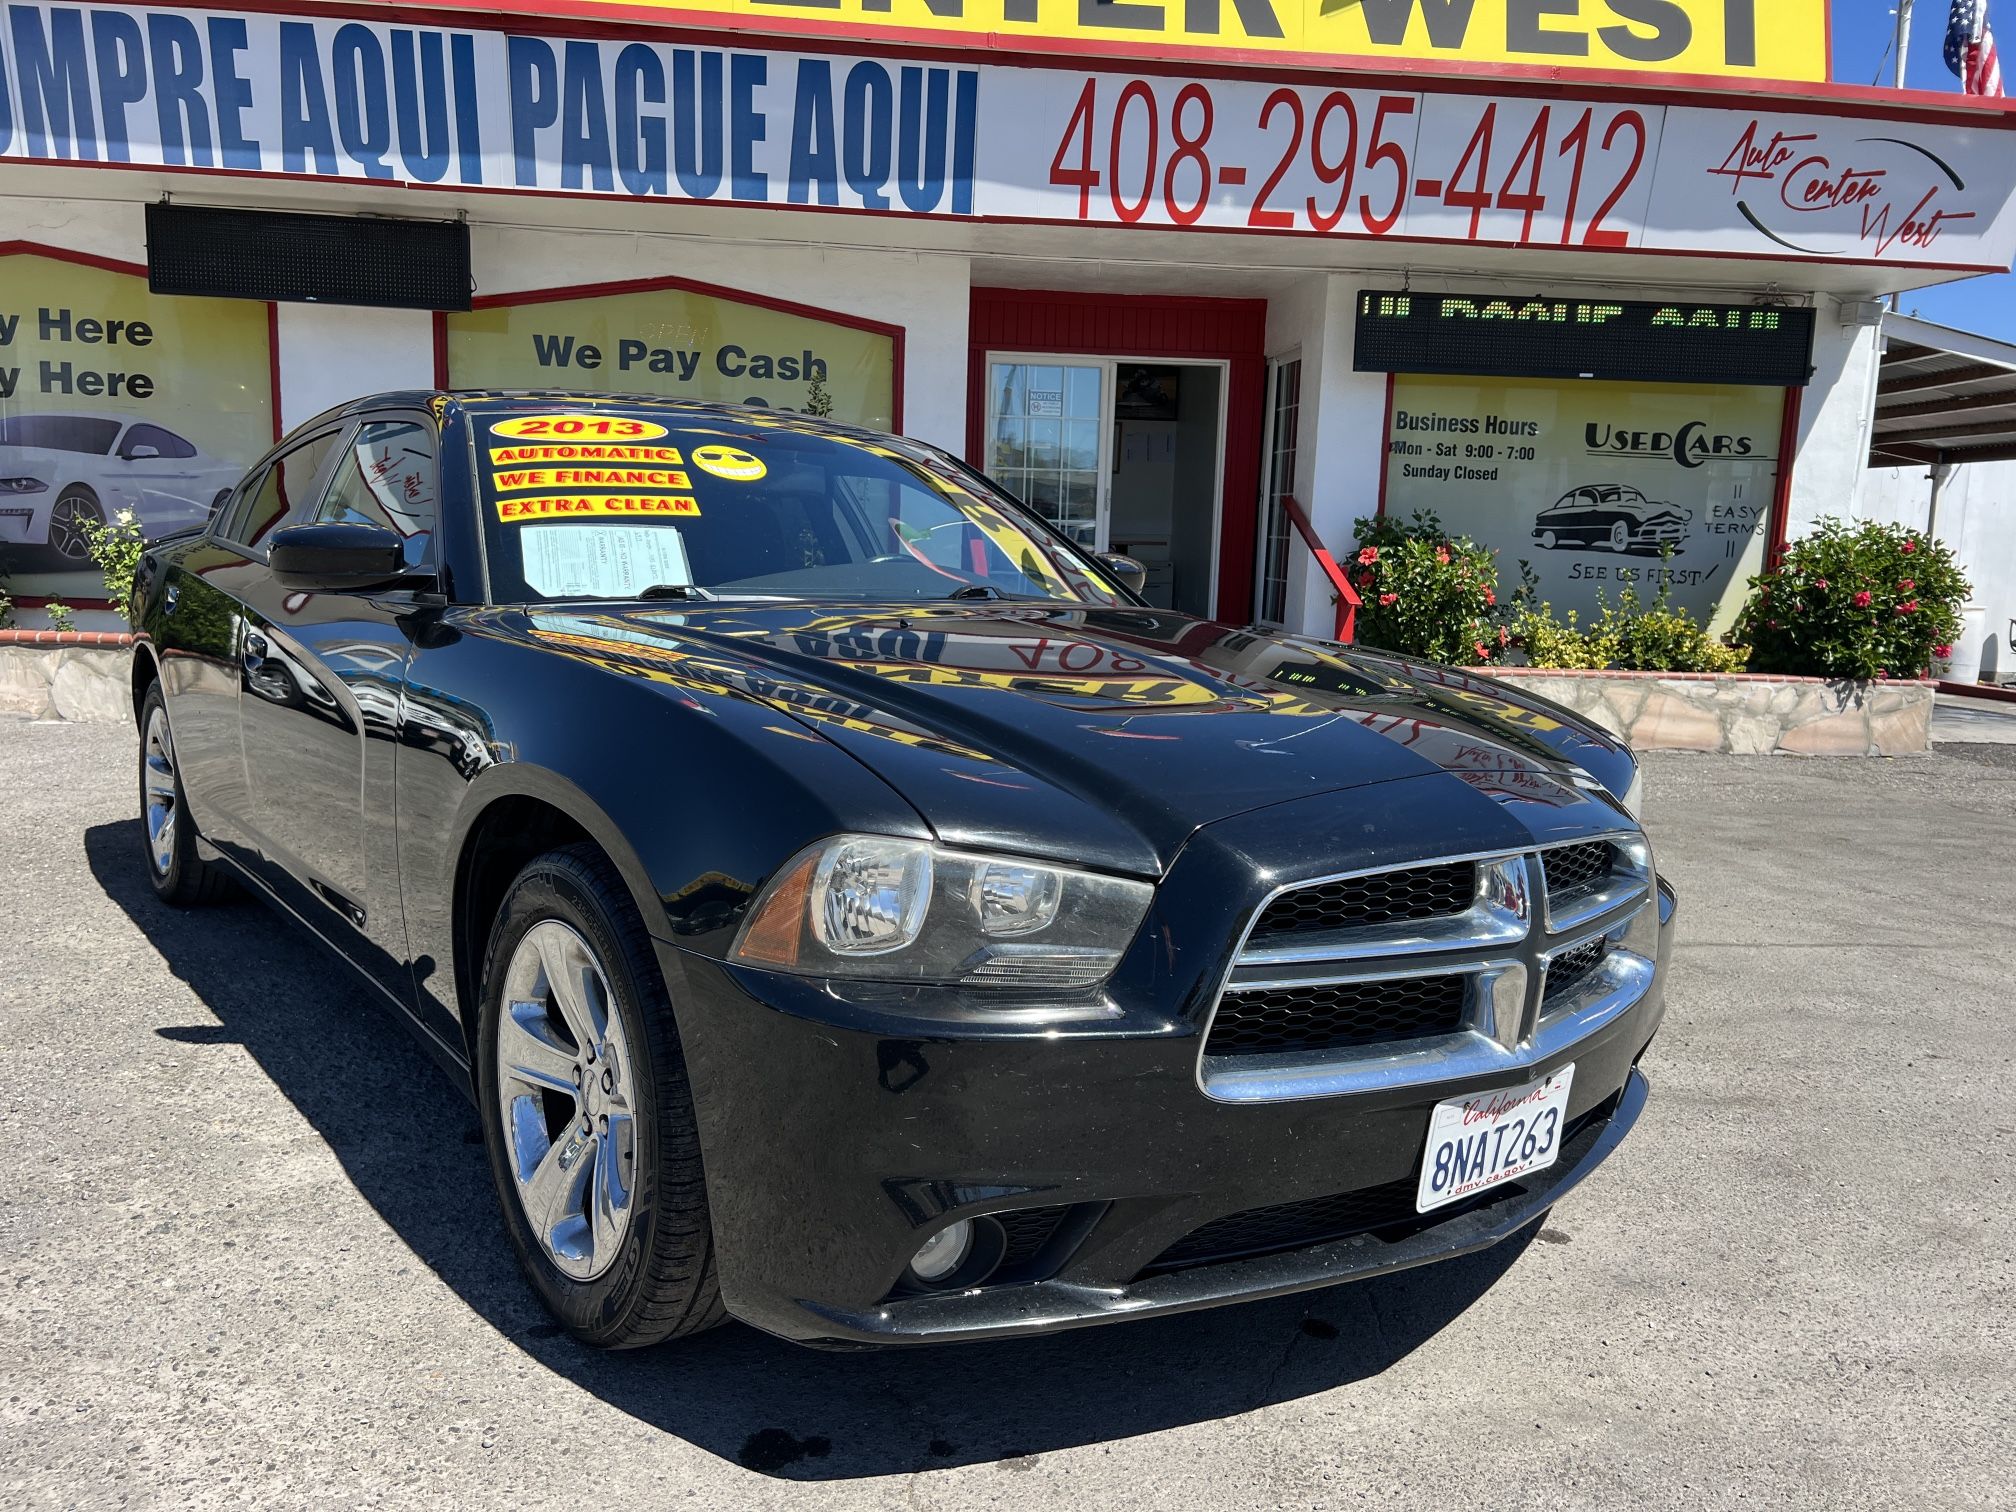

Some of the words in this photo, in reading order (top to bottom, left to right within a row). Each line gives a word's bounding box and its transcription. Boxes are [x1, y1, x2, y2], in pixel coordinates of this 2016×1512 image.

[0, 5, 262, 170] MPRE
[280, 20, 483, 185] AQUI
[507, 35, 768, 202] PAGUE
[786, 58, 979, 214] AQUI
[1049, 76, 1647, 247] 408-295-4412
[1706, 120, 1817, 195] Auto
[1781, 155, 1886, 212] Center
[1860, 186, 1976, 258] West
[38, 308, 153, 347] Here
[532, 334, 601, 369] We
[618, 339, 700, 381] Pay
[716, 344, 827, 382] Cash
[39, 361, 154, 398] Here
[1030, 392, 1061, 401] NOTICE
[516, 421, 645, 435] 2013
[1396, 411, 1479, 434] Business
[1485, 415, 1538, 436] Hours
[496, 447, 676, 462] AUTOMATIC
[1394, 440, 1422, 456] Mon
[1436, 443, 1457, 457] Sat
[1465, 444, 1493, 458] 9:00
[1507, 446, 1535, 460] 7:00
[500, 472, 545, 487] WE
[555, 471, 685, 485] FINANCE
[1403, 463, 1450, 481] Sunday
[1454, 466, 1498, 481] Closed
[501, 498, 592, 516] EXTRA
[605, 498, 692, 512] CLEAN
[1712, 505, 1764, 519] EASY
[1704, 522, 1765, 536] TERMS
[1568, 563, 1607, 580] SEE
[1615, 566, 1640, 581] US
[1463, 1088, 1548, 1126] California
[1431, 1106, 1558, 1192] 8NAT263
[1455, 1163, 1526, 1194] dmv.ca.gov
